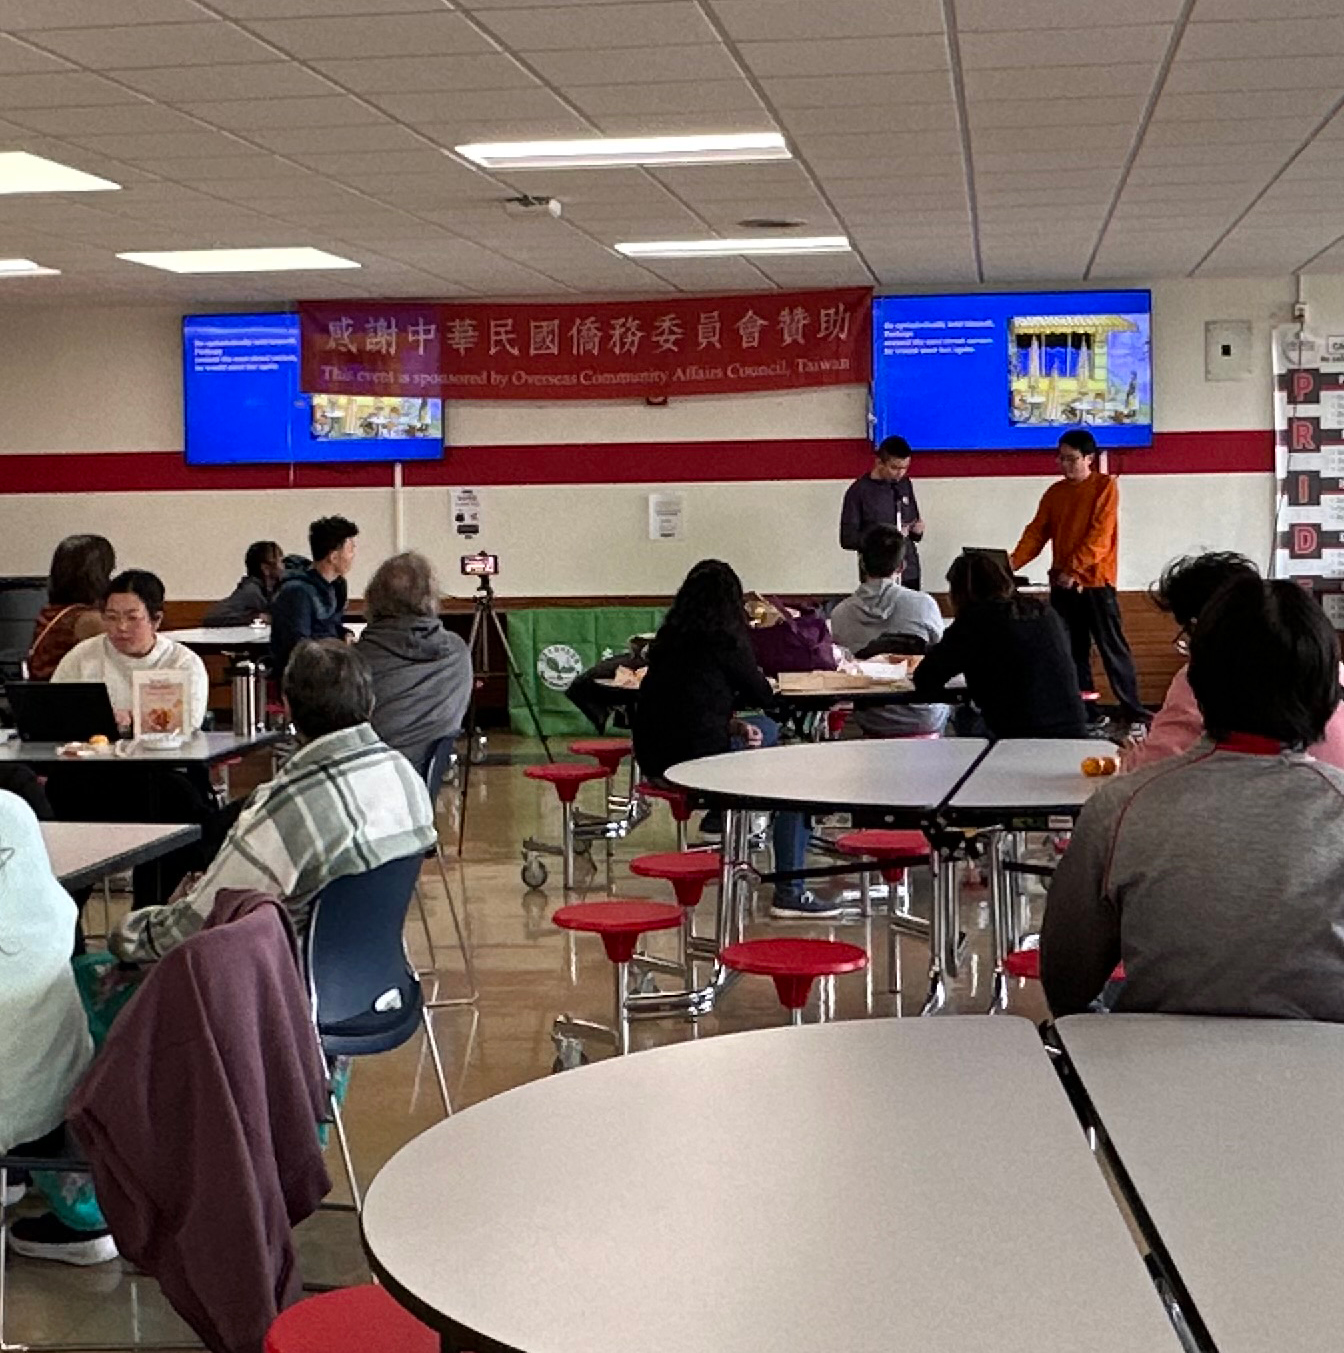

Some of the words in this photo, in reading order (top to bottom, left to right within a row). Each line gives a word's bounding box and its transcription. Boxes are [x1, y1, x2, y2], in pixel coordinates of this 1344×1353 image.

[320, 365, 354, 382] This
[356, 369, 394, 385] event
[412, 370, 488, 391] sponsored
[490, 370, 506, 389] by
[511, 370, 578, 386] Overseas
[580, 368, 669, 386] Community
[672, 364, 724, 383] Affairs
[726, 361, 791, 379] Council,
[796, 357, 851, 374] Taiwan
[1292, 420, 1316, 449] R
[1294, 526, 1318, 554] D
